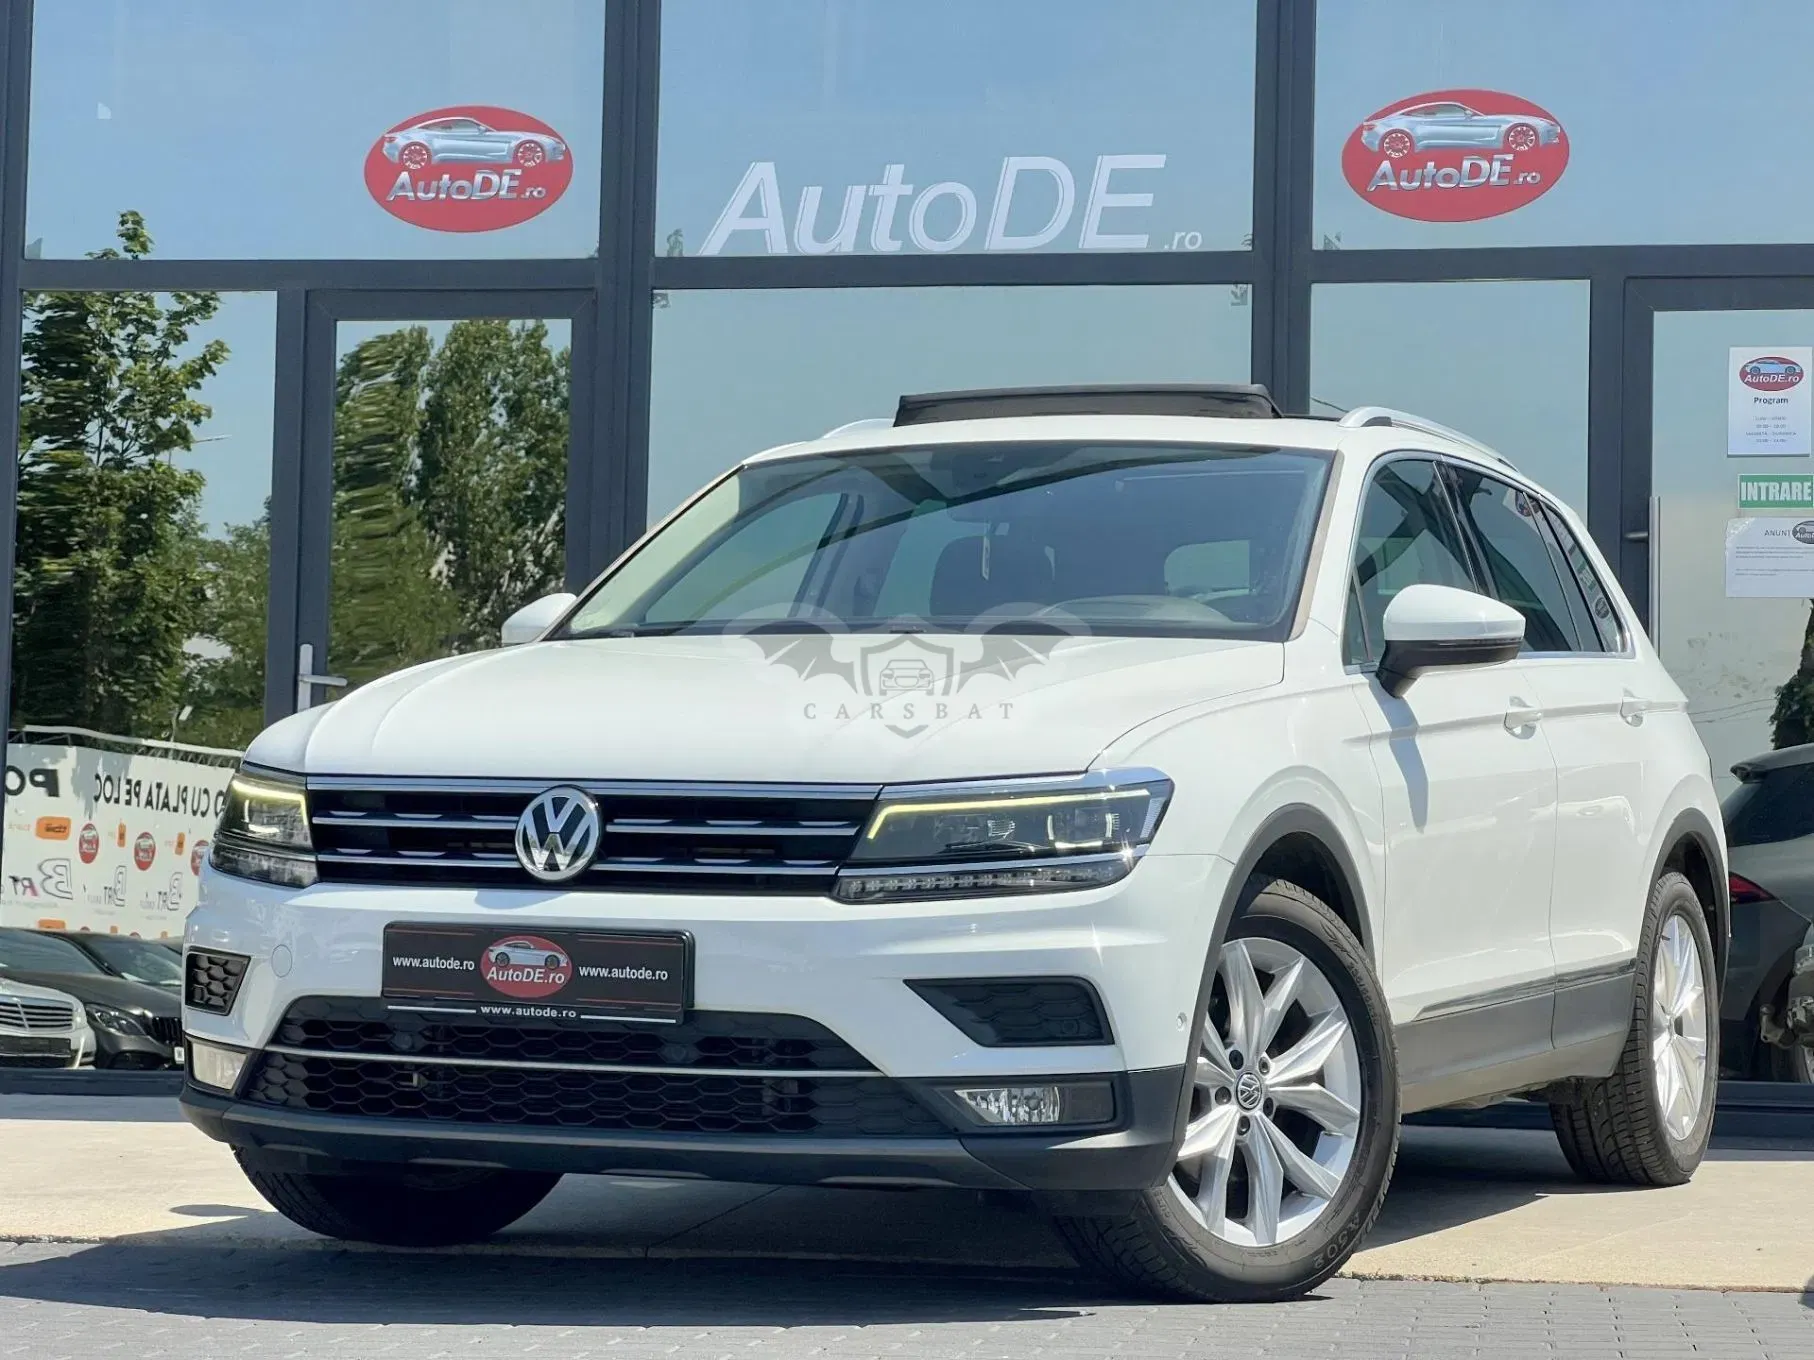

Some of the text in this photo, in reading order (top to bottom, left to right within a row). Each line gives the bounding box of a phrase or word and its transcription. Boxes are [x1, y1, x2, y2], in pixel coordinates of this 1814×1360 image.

[1744, 374, 1800, 383] AutoDE.ro
[1753, 397, 1789, 405] Program
[1740, 481, 1812, 501] INTRARE
[392, 956, 475, 971] www.autode.ro
[487, 966, 565, 985] AutoDE.ro
[578, 965, 668, 981] www.autode.ro
[480, 1004, 577, 1019] www.autode.ro
